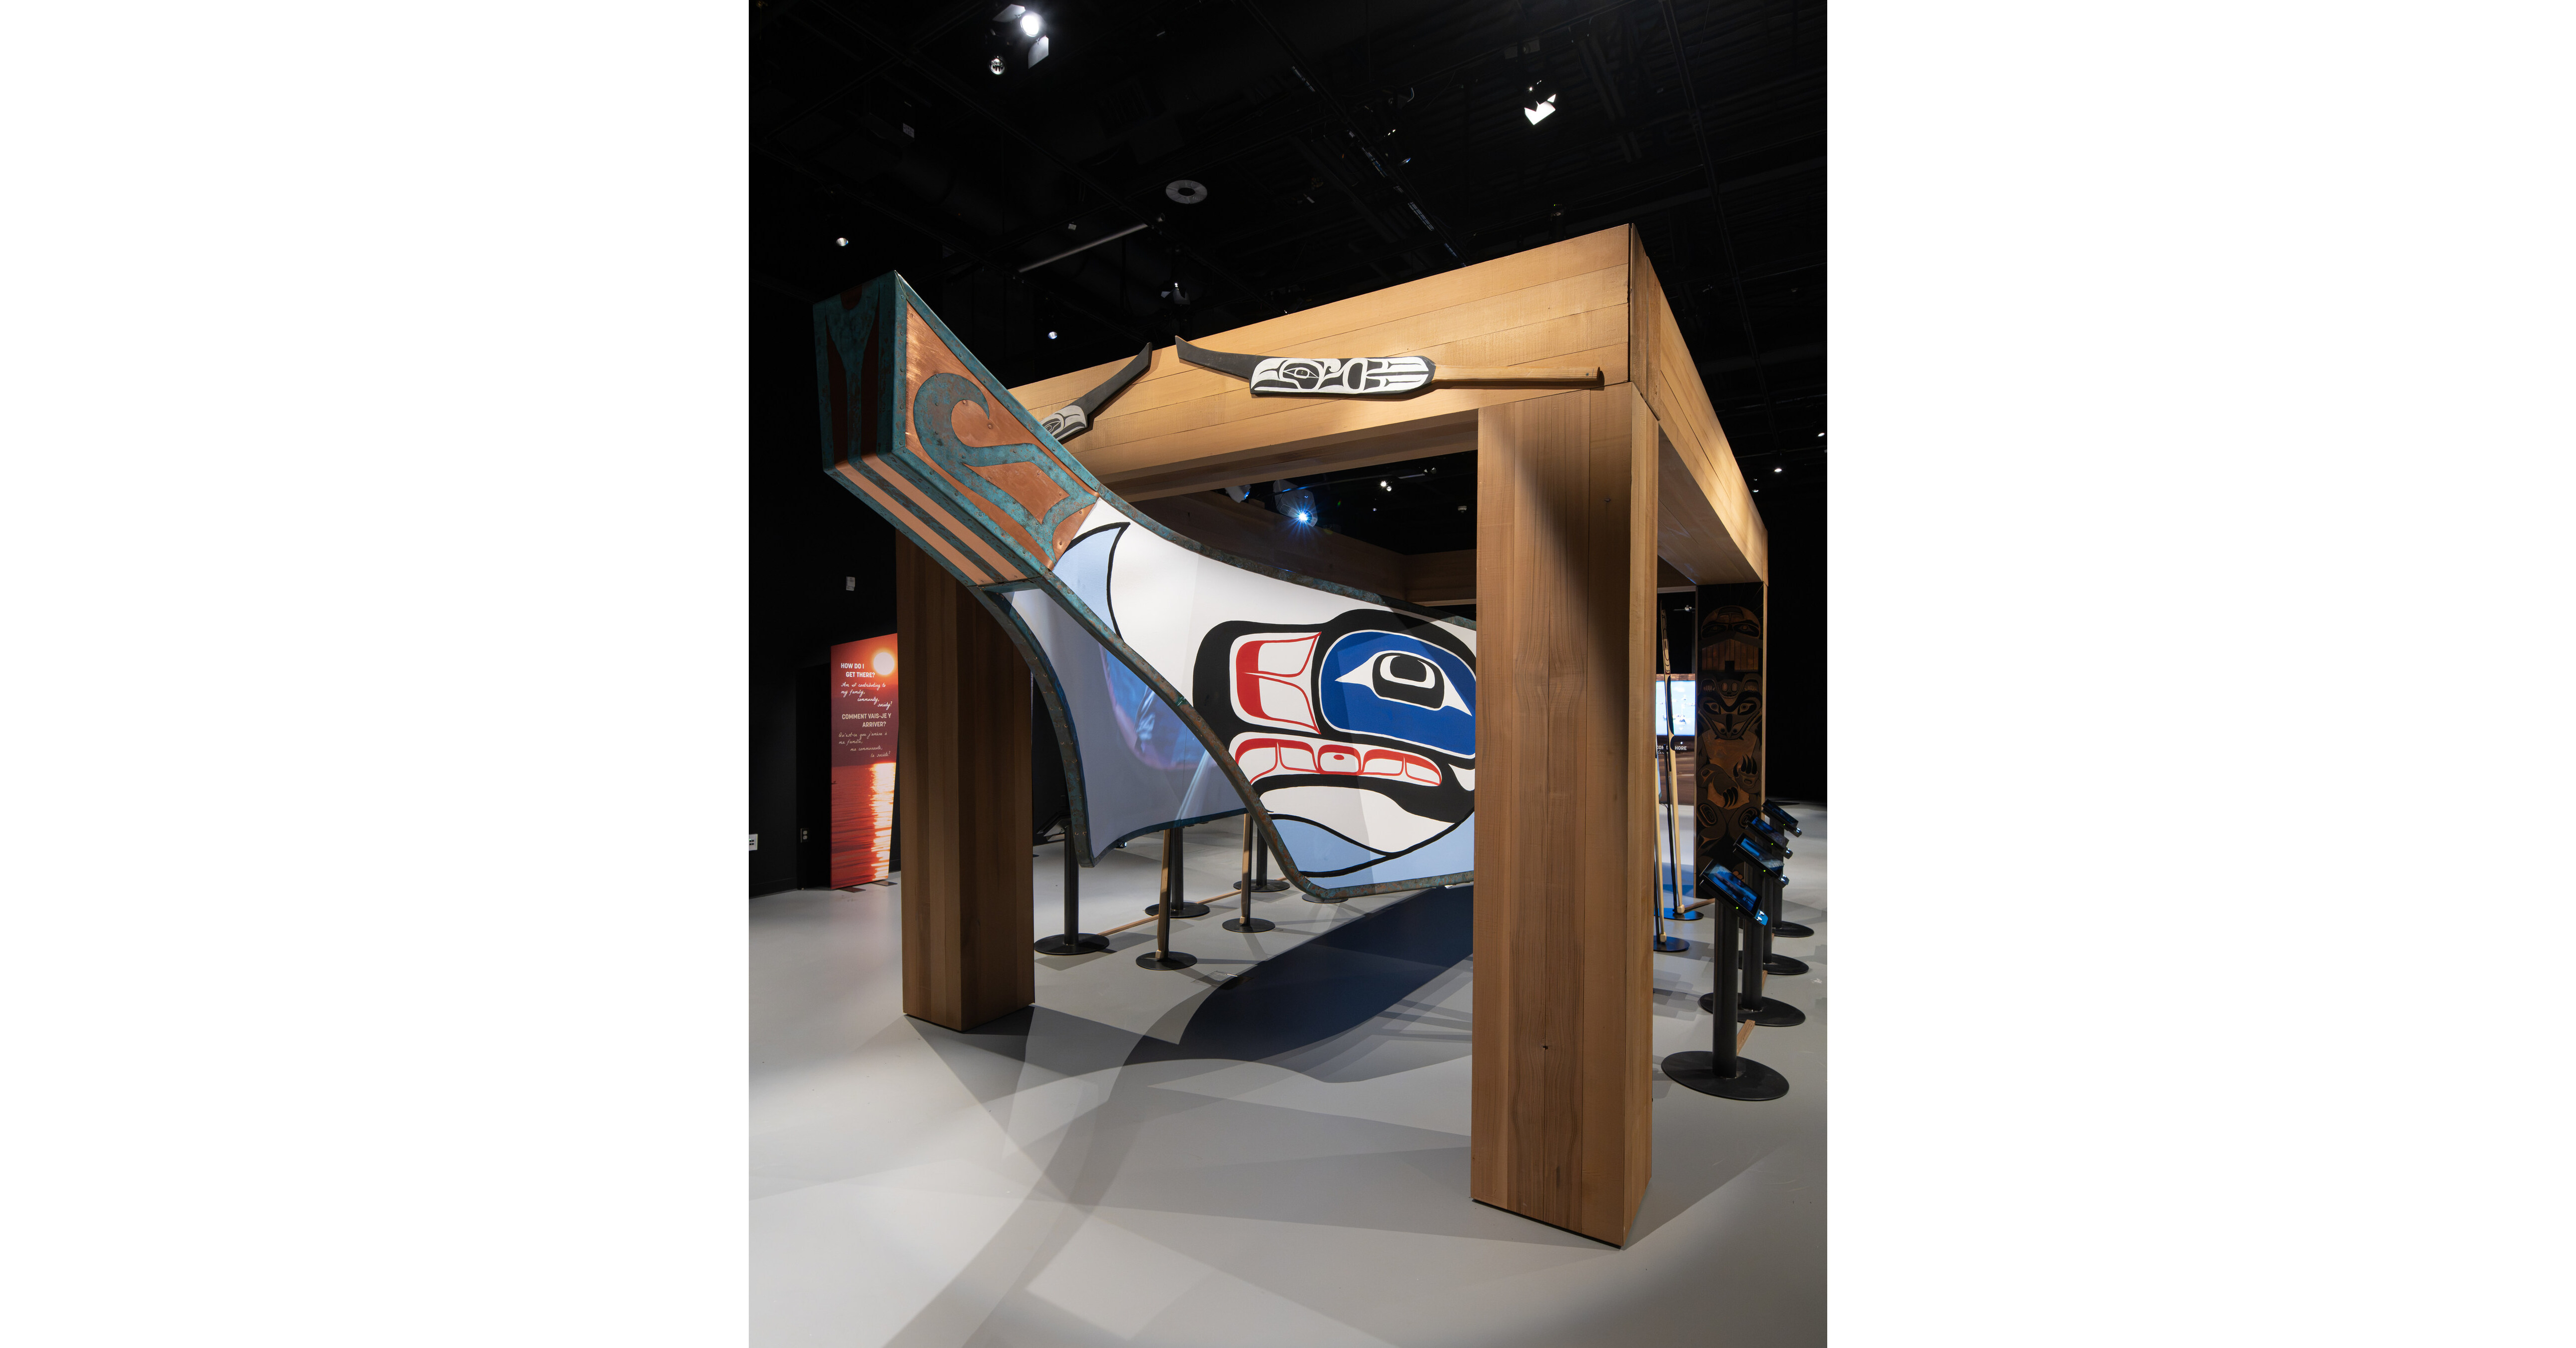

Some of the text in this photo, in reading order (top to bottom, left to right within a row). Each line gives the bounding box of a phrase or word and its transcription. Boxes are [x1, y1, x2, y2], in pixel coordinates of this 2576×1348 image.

[858, 682, 881, 691] contributing
[849, 689, 865, 698] family,
[857, 696, 880, 705] community,
[877, 701, 893, 710] society?
